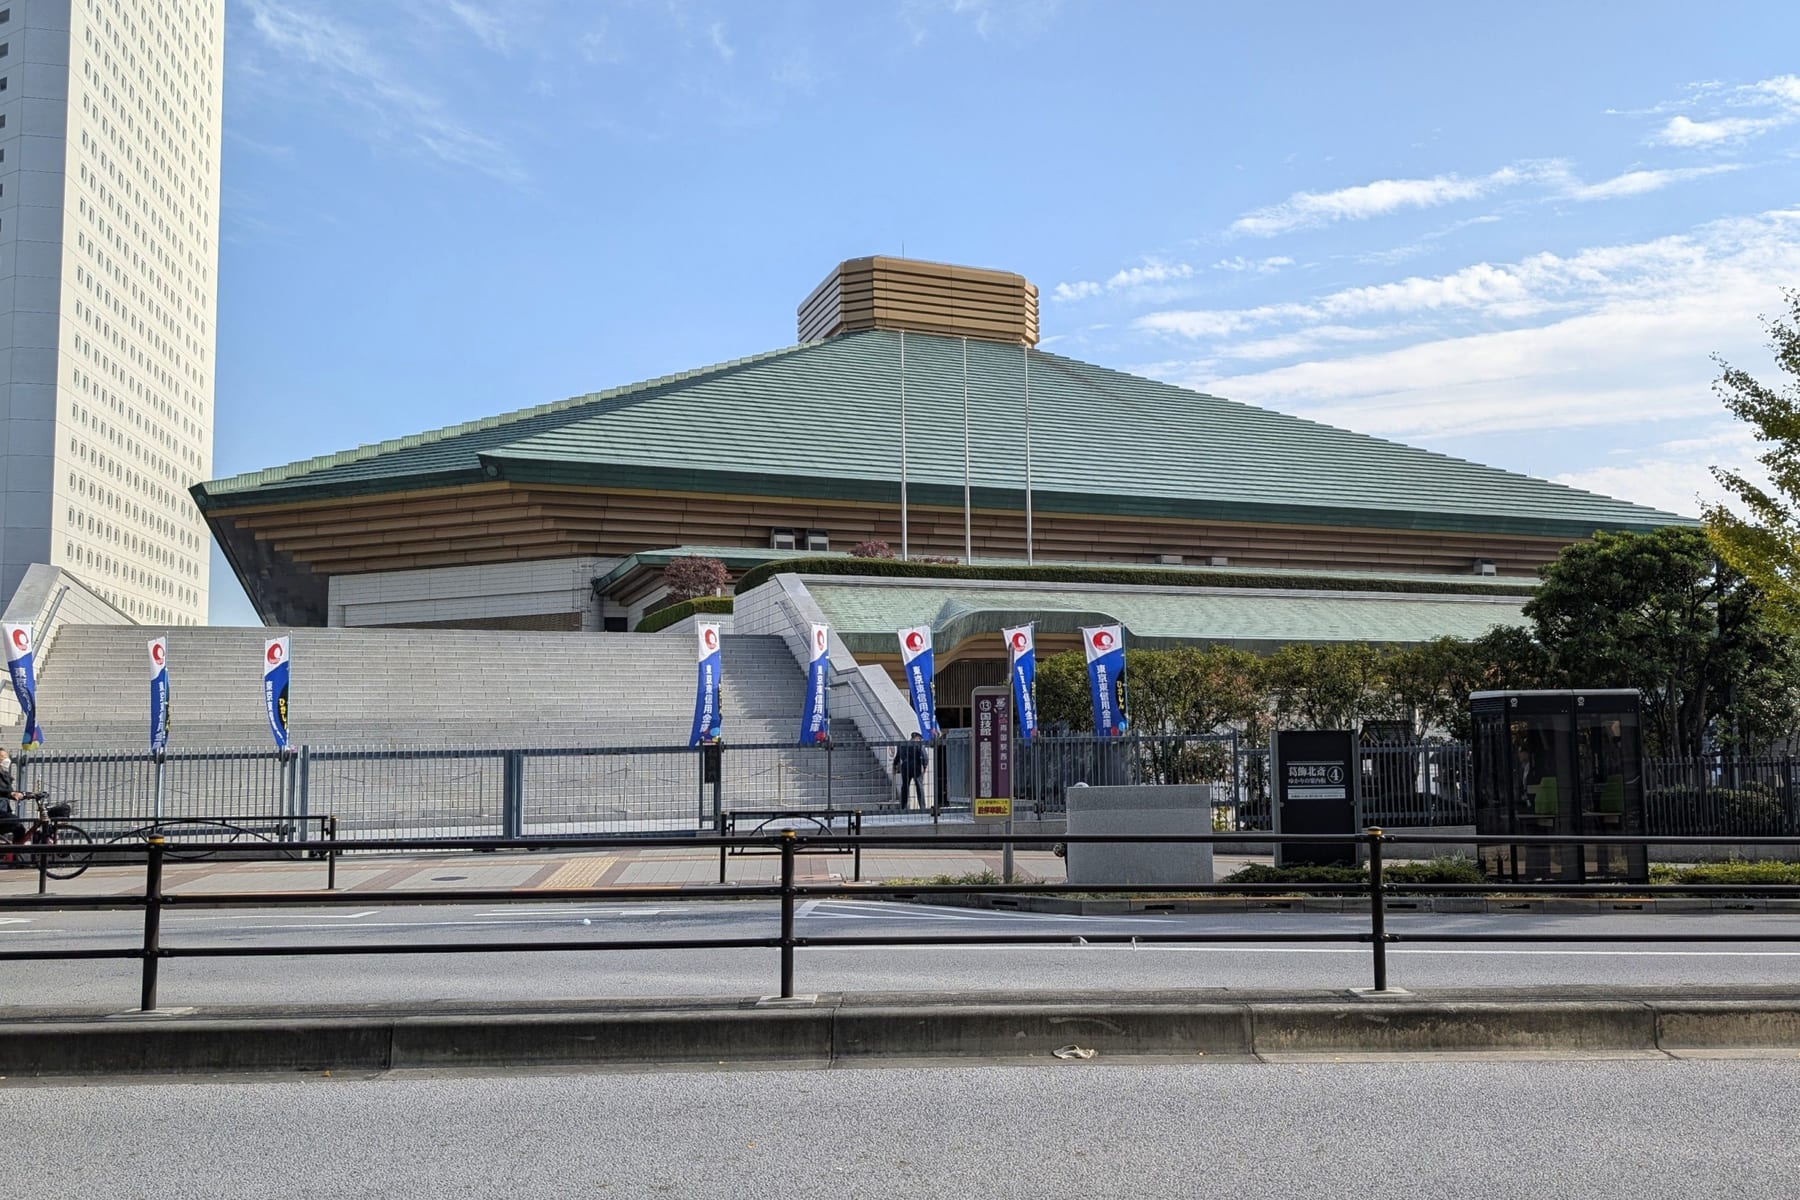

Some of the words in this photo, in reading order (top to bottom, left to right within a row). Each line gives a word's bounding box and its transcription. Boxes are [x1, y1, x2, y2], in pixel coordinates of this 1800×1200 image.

[699, 664, 713, 733] 東京東信用金庫
[809, 665, 823, 732] 東京東信用金庫
[912, 665, 932, 730] 東京東信用金庫
[1096, 664, 1112, 728] 東京東信用金庫
[1116, 680, 1125, 710] ひがしん
[1289, 766, 1326, 777] 葛飾北斎
